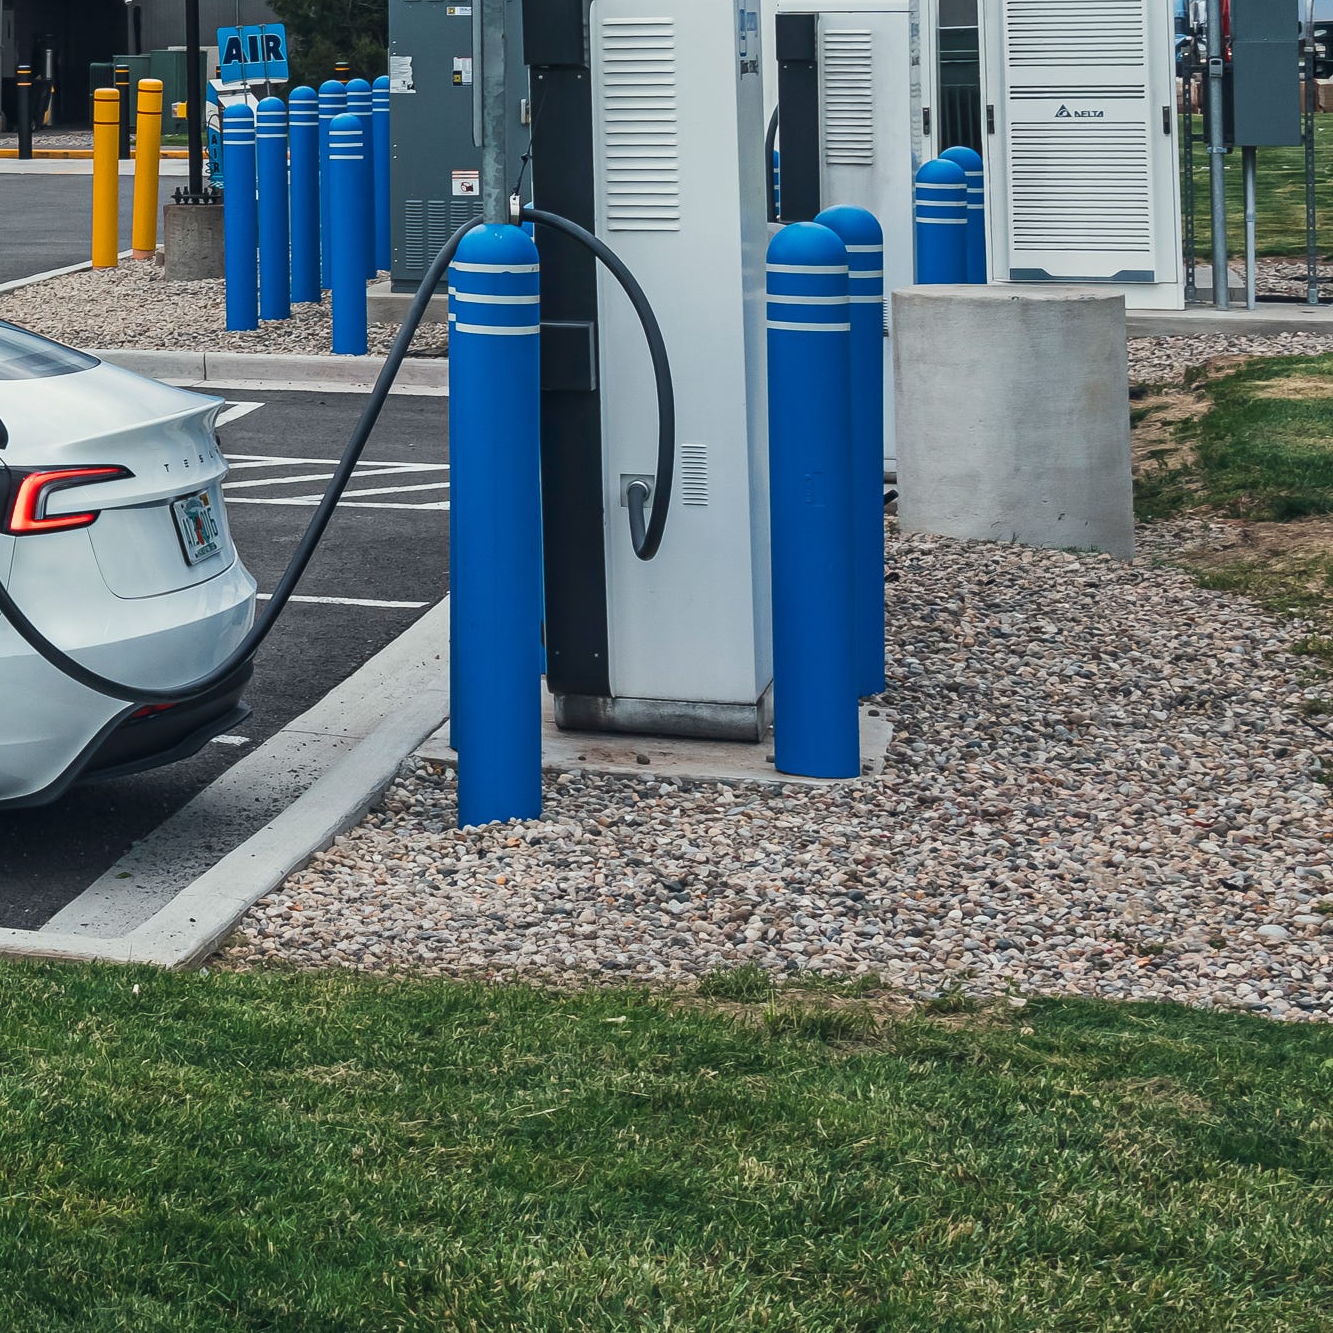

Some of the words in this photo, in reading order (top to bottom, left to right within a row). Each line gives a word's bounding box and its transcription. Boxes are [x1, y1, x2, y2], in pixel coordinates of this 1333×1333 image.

[222, 33, 285, 65] AIR
[1074, 110, 1104, 118] DELTA
[211, 134, 220, 173] AIR
